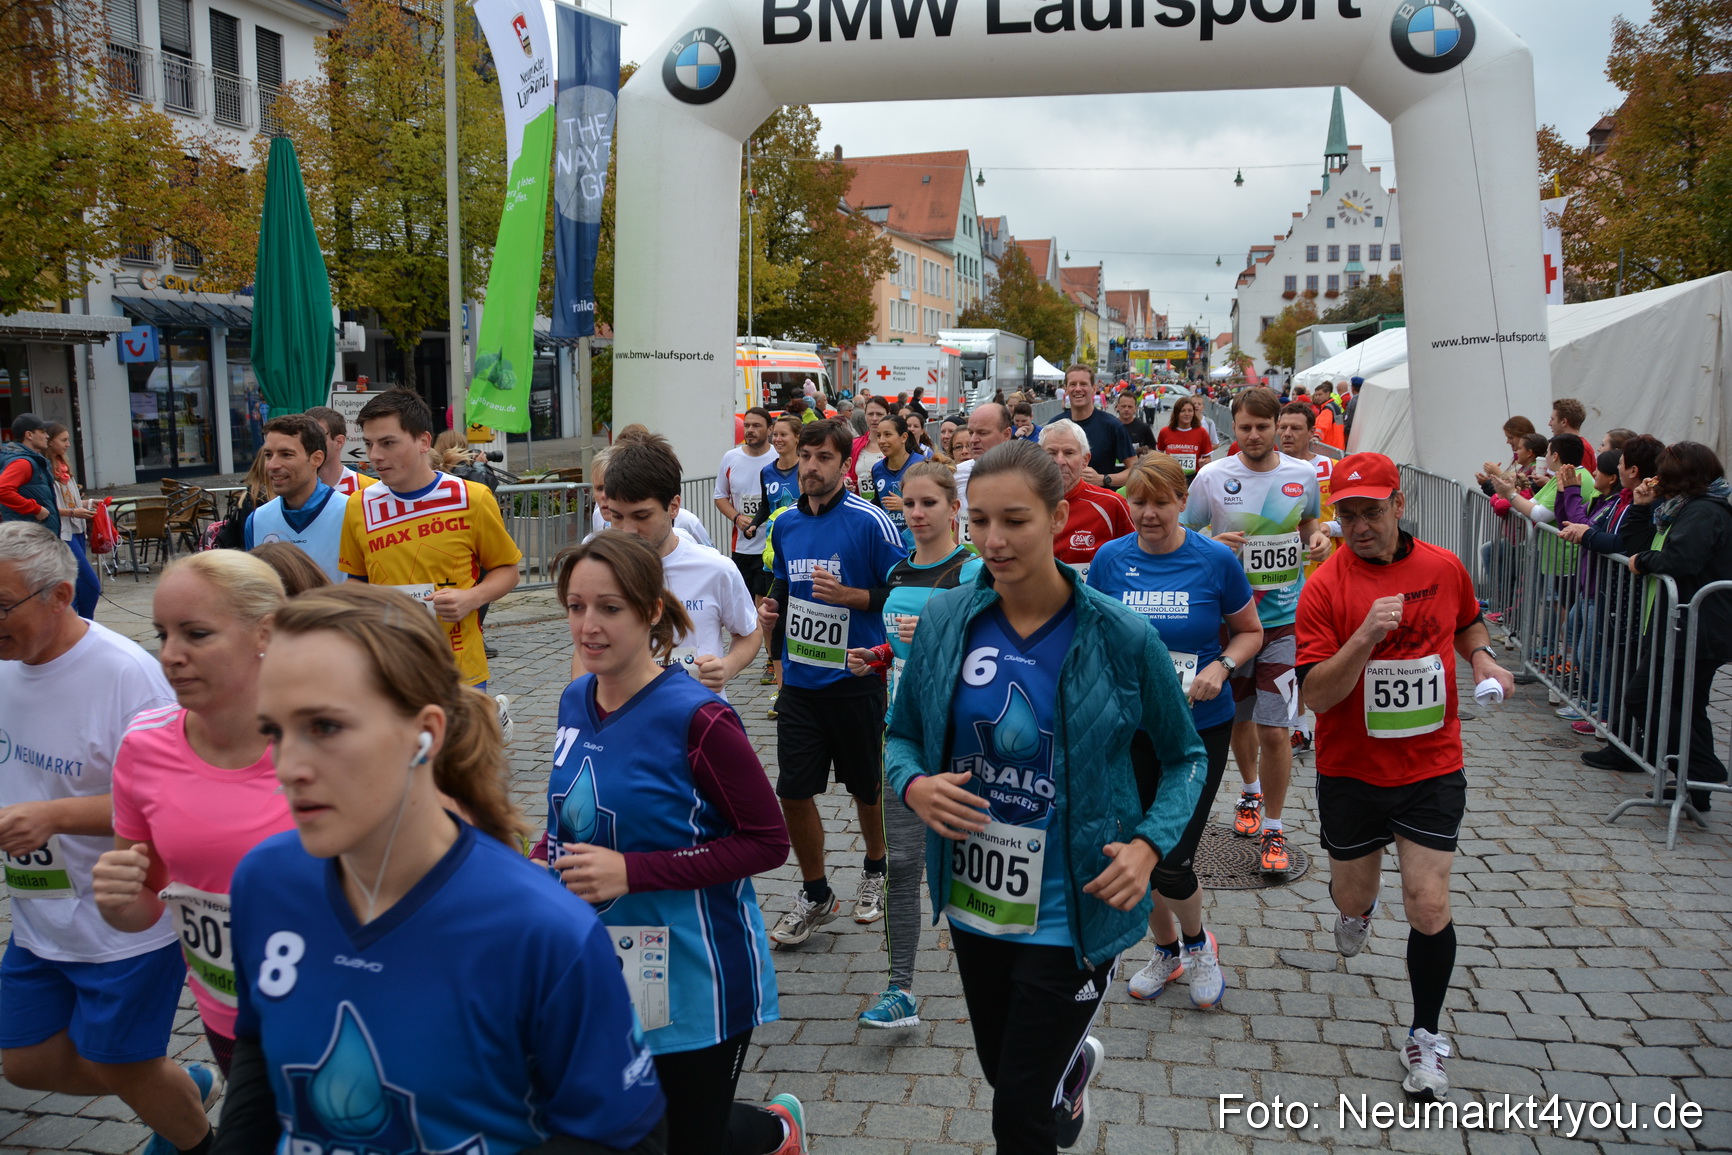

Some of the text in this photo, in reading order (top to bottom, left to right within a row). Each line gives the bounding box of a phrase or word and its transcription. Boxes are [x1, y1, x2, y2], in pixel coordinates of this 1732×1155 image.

[763, 0, 1361, 45] BMW Lauspo
[671, 28, 729, 56] BMW
[562, 113, 611, 144] THE
[165, 274, 190, 293] City
[1431, 331, 1547, 349] www.bmw-laufsport.de
[615, 350, 714, 361] www.bmw-laufsport.de
[765, 481, 780, 495] 10
[877, 478, 886, 492] 9
[368, 517, 471, 553] MAX BÖGL
[1267, 539, 1293, 547] Neumarkt
[1251, 547, 1297, 570] 5058
[1262, 574, 1288, 584] Philipp
[1122, 591, 1190, 606] HUBER
[789, 602, 838, 620] PARTL Neumarkt
[790, 613, 842, 646] 5020
[796, 644, 827, 659] Florian
[962, 646, 999, 686] 6
[1367, 665, 1434, 676] PARTL Neumarkt
[1374, 675, 1438, 709] 5311
[14, 744, 83, 777] NEUMARKT
[955, 756, 1056, 799] FIBALO
[990, 789, 1039, 812] BASKETS
[974, 831, 1022, 850] Neumarkt
[952, 842, 1030, 898] 5005
[966, 891, 996, 919] Anna
[257, 930, 306, 998] 8
[1075, 991, 1099, 1002] adidas
